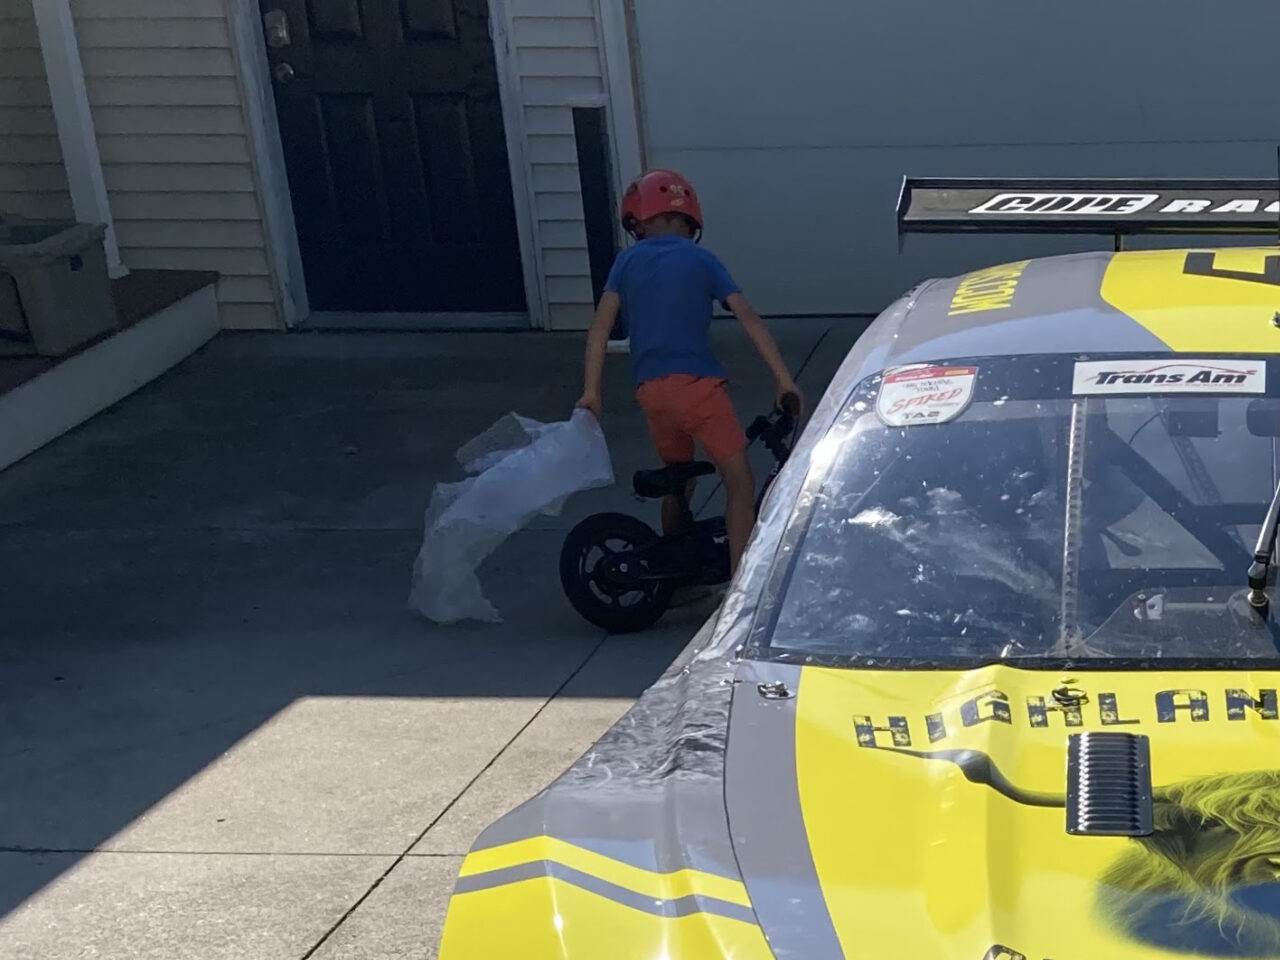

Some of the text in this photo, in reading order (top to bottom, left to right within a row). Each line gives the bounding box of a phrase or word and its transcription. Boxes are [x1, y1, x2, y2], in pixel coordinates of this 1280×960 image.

[982, 195, 1145, 213] COPE
[1095, 370, 1248, 385] Trans Am
